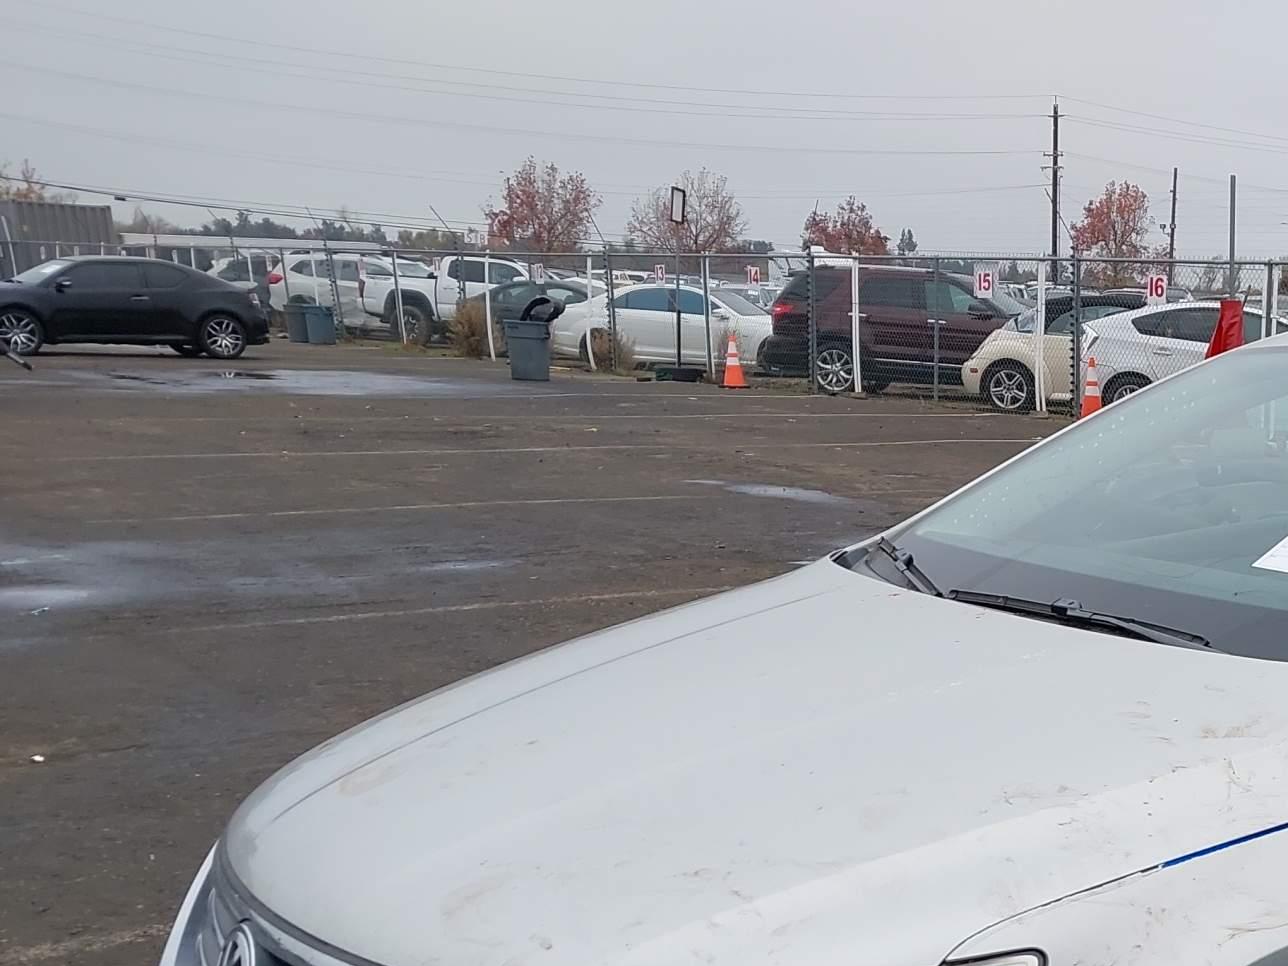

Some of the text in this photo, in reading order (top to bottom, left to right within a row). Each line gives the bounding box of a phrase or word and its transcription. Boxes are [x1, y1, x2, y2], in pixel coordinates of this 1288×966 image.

[536, 264, 543, 279] 12
[655, 264, 665, 281] 13
[749, 267, 760, 283] 14
[978, 272, 992, 291] 15
[1150, 277, 1165, 297] 16
